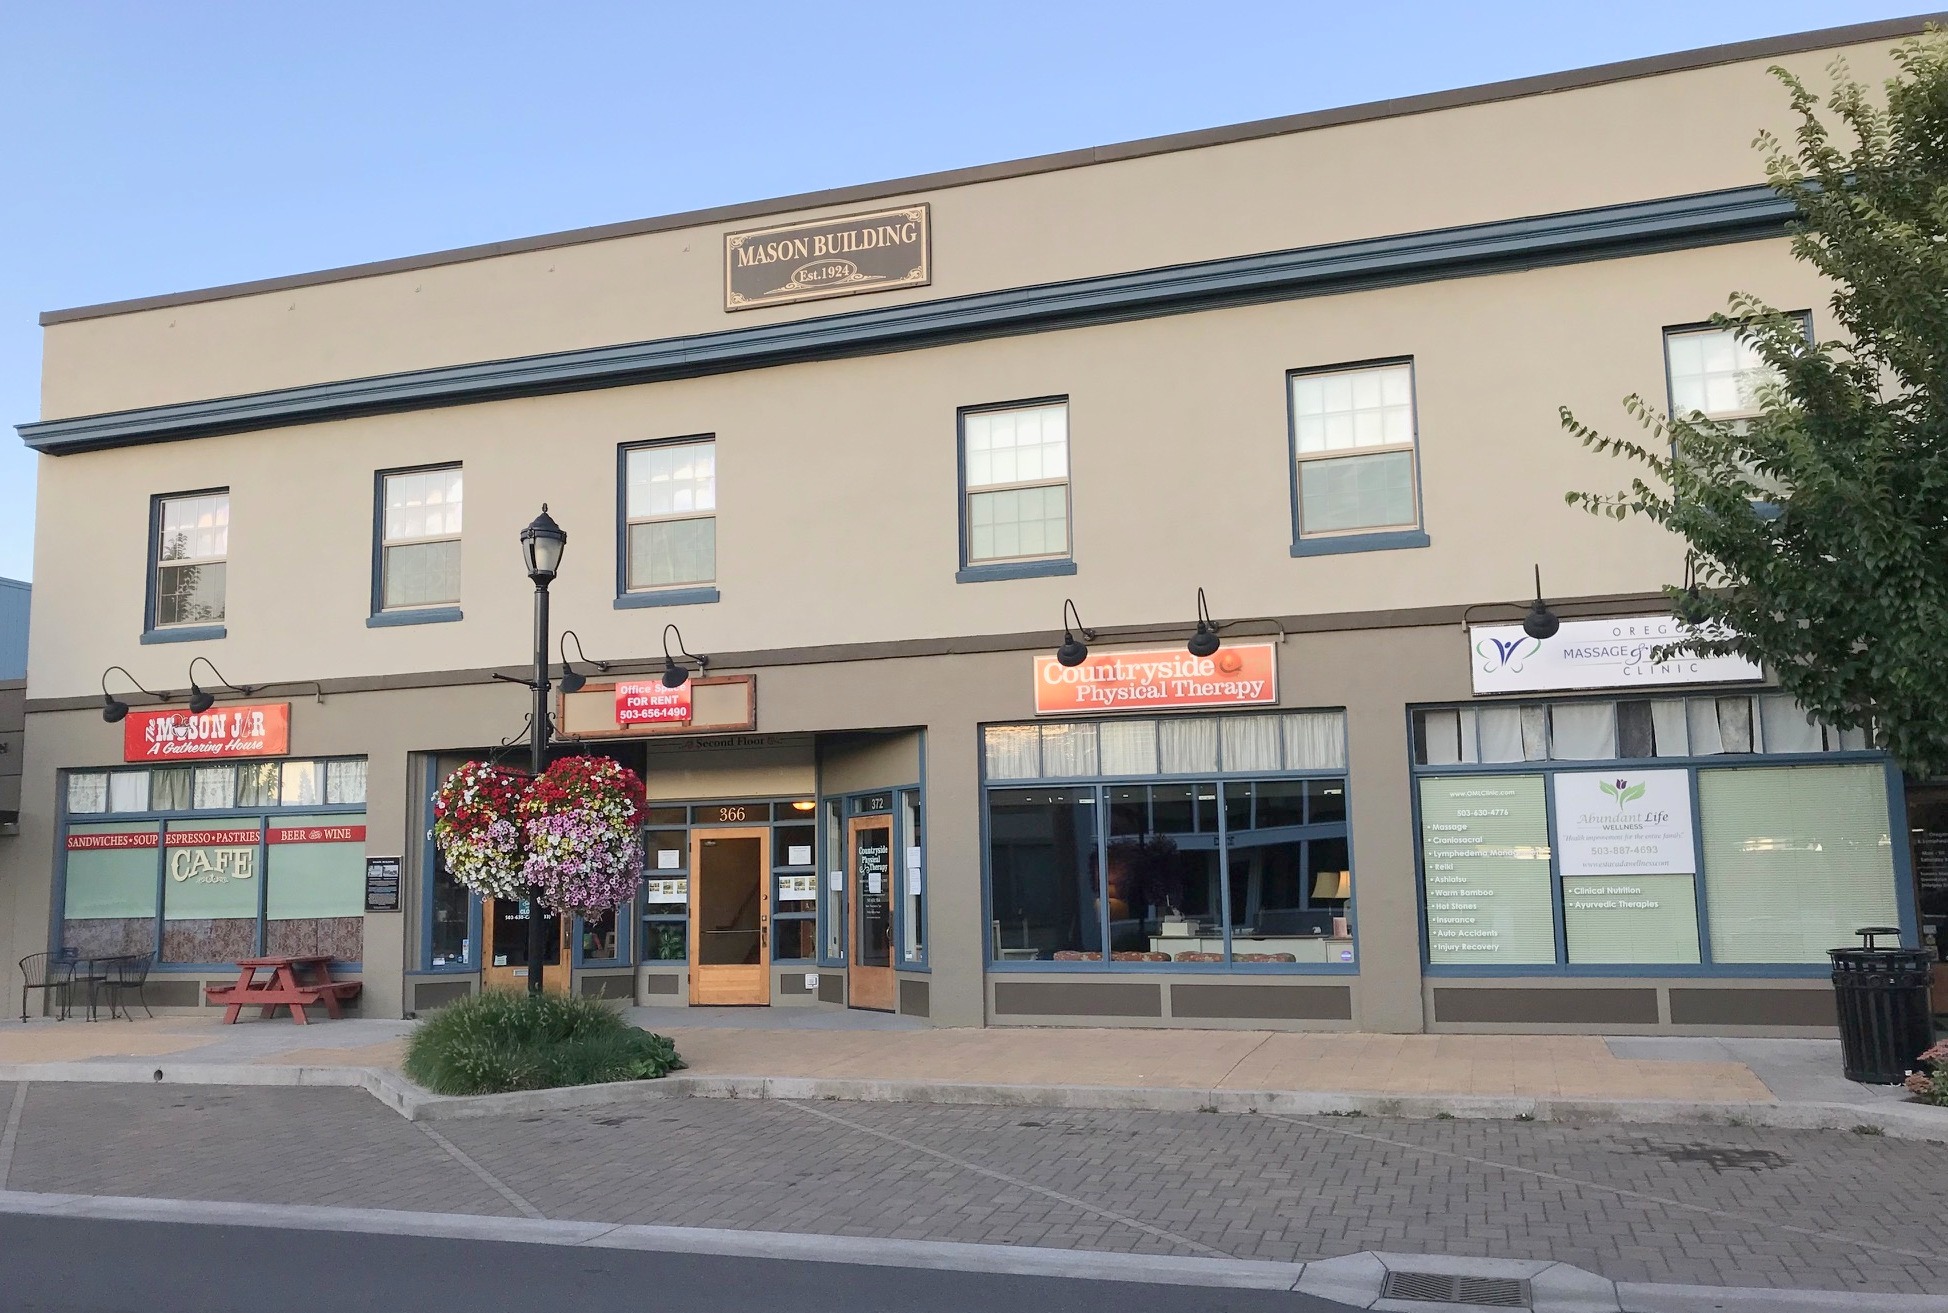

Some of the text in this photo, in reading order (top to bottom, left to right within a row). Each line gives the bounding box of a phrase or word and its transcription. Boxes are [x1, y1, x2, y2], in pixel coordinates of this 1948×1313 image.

[738, 222, 918, 267] MASON BUILDING
[1612, 623, 1687, 637] OREGO
[1563, 645, 1628, 659] MASSAGE
[1043, 655, 1215, 686] Countryside
[1623, 662, 1698, 675] CLINIC
[620, 685, 652, 695] Office
[1075, 679, 1265, 705] Physical Therapy
[627, 695, 679, 707] FOR RENT
[620, 707, 687, 720] 503-656-1490
[156, 713, 227, 742] MSON
[146, 739, 264, 755] A Gathering House
[696, 737, 764, 749] Second Floor
[871, 798, 884, 810] 372
[719, 807, 746, 822] 366
[1457, 808, 1509, 817] 503-630-4776
[1577, 811, 1669, 825] Abundant Life
[1432, 824, 1468, 832] Massage
[165, 831, 261, 844] ESPRESSO PASTRIES
[281, 830, 306, 841] BEER
[324, 828, 352, 839] WINE
[1433, 836, 1483, 844] Craniosacral
[67, 834, 158, 848] SANDWICHES SOUP
[858, 845, 888, 856] Countryside
[1433, 849, 1488, 858] Lymphedema
[171, 848, 253, 882] CAFE
[1434, 889, 1458, 897] Warm
[1573, 886, 1641, 895] Clinical Nutrition
[1451, 902, 1477, 910] Stones
[1574, 900, 1659, 909] Ayurvedic Therapies
[1436, 916, 1475, 924] Insurance
[1437, 929, 1498, 937] Auto Accidents
[1438, 943, 1499, 952] Injury Recovery
